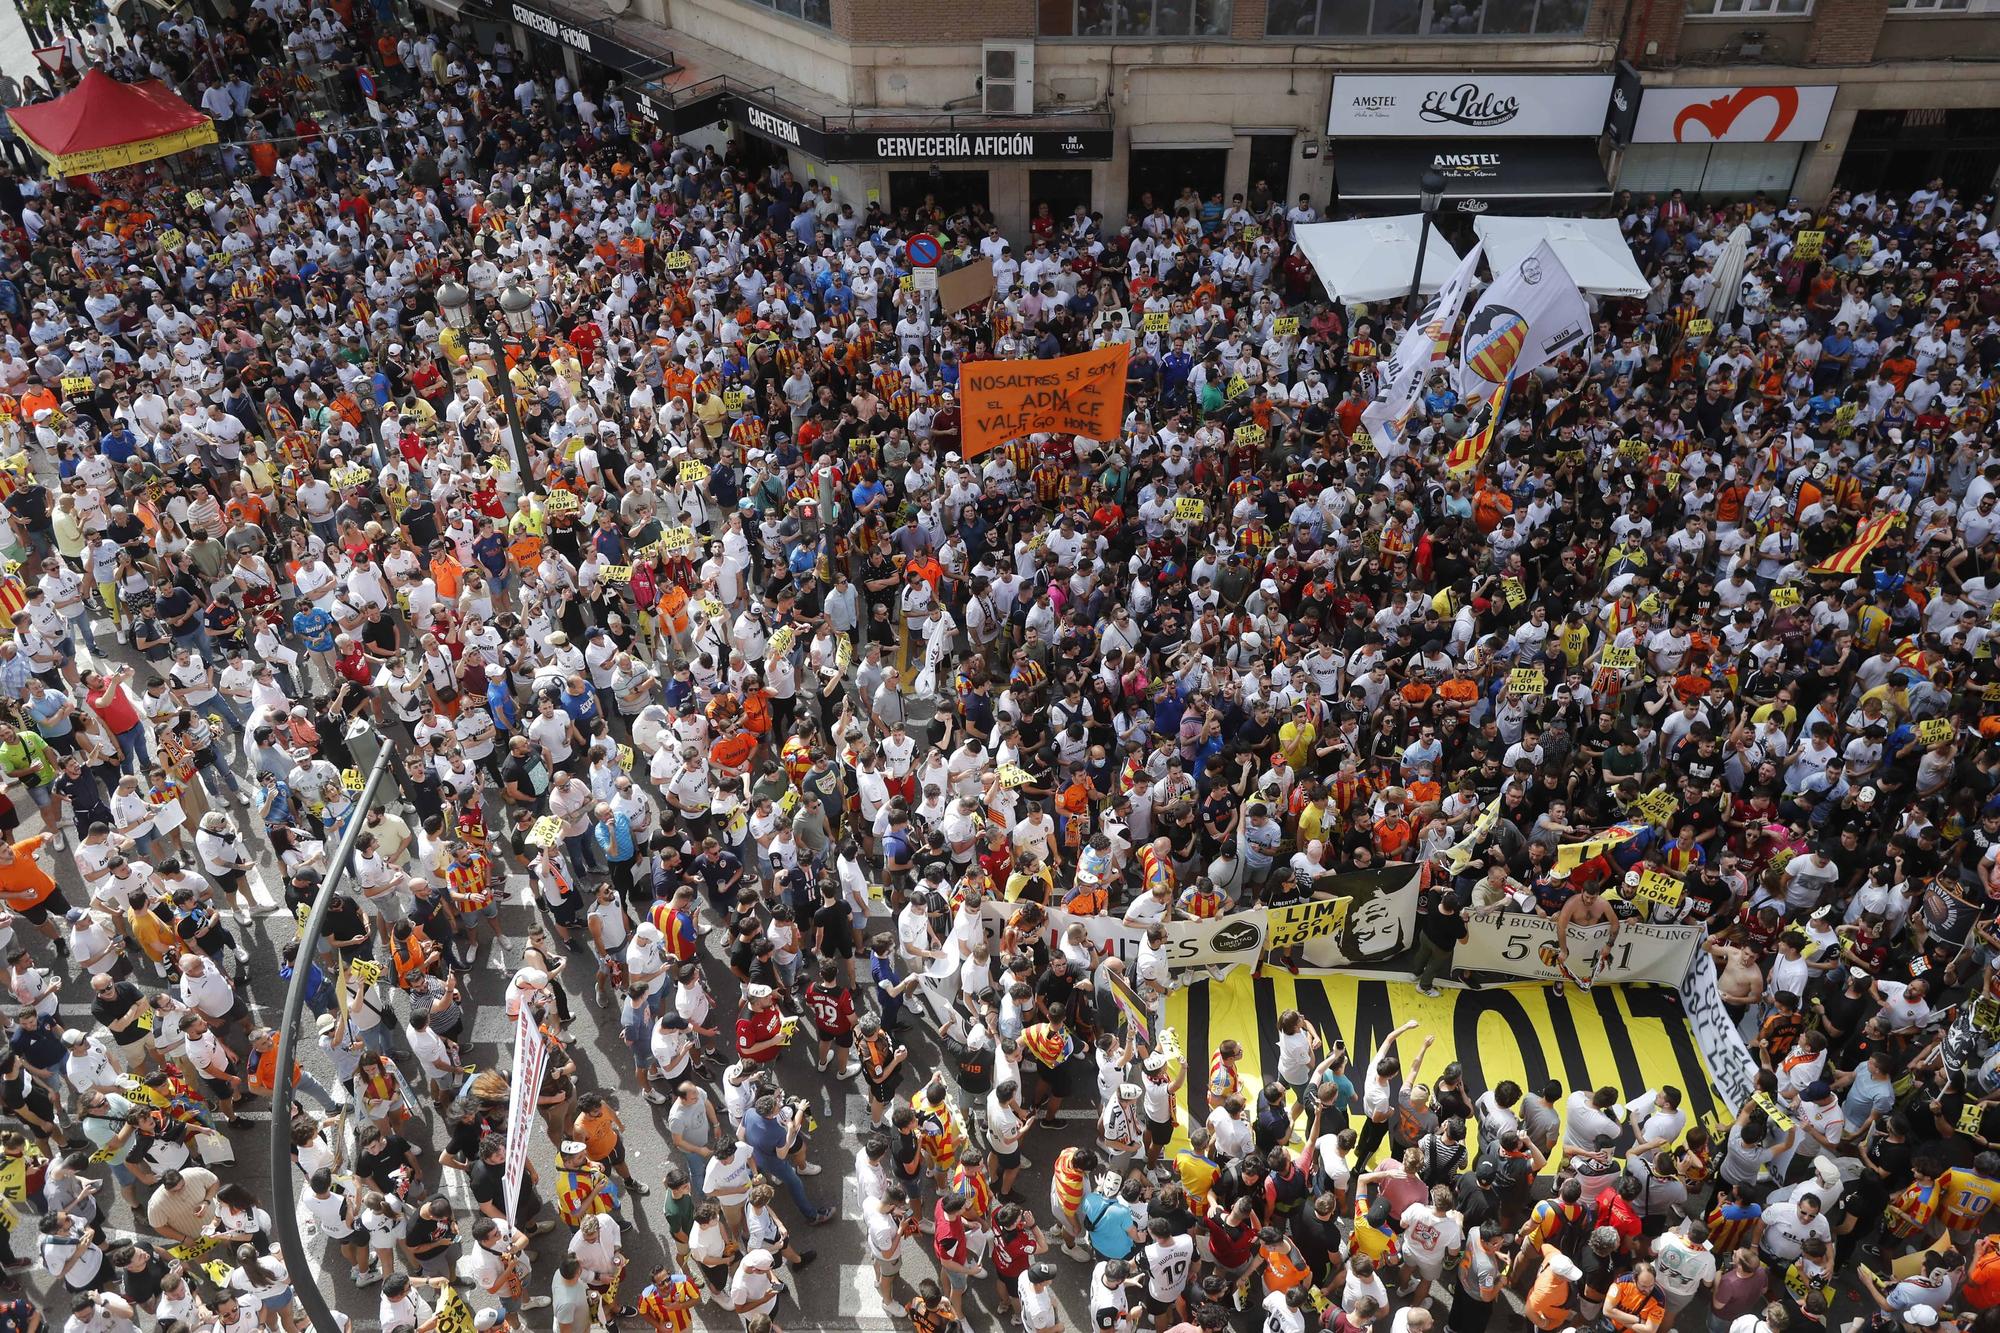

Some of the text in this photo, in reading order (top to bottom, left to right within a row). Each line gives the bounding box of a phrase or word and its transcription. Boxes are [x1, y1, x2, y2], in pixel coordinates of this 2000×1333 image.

[513, 4, 559, 39] CERVECERÍA
[1351, 96, 1397, 106] AMSTEL
[1449, 83, 1520, 118] Palco
[636, 102, 660, 121] TURIA
[748, 107, 801, 146] CAFETERÍA
[877, 133, 1034, 157] CERVECERÍA AFICIÓN
[1433, 153, 1501, 166] AMSTEL
[161, 230, 176, 241] LIM
[670, 253, 686, 261] LIM
[1279, 318, 1294, 326] LIM
[1275, 328, 1298, 336] HOME
[1553, 330, 1570, 342] 1919
[969, 374, 1061, 392] NOSALTRES
[1087, 362, 1117, 378] SOM
[987, 401, 1003, 409] EL
[1033, 416, 1103, 435] GO HOME
[1240, 425, 1257, 434] LIM
[1239, 436, 1262, 447] HOME
[680, 460, 701, 470] HOME
[346, 469, 363, 479] LIM
[686, 472, 704, 480] LIM
[551, 490, 569, 498] LIM
[548, 501, 579, 510] HOME
[1181, 499, 1199, 507] LIM
[1175, 511, 1203, 520] HOME
[666, 527, 684, 538] LIM
[664, 537, 693, 550] HOME
[641, 544, 657, 555] LIM
[520, 550, 538, 561] bwin
[606, 566, 626, 574] LIM
[1775, 589, 1791, 597] LIM
[1698, 601, 1711, 609] LIM
[1568, 634, 1581, 642] LIM
[1568, 642, 1581, 651] OUT
[1610, 647, 1630, 656] LIM
[1603, 659, 1636, 668] HOME
[1516, 670, 1537, 678] LIM
[1510, 683, 1542, 692] HOME
[1926, 720, 1946, 729] LIM
[1920, 732, 1952, 744] HOME
[1655, 793, 1674, 806] LIM
[1640, 800, 1670, 821] HOME
[544, 819, 561, 847] HOME
[1649, 873, 1676, 889] LIM
[1654, 884, 1666, 893] GO
[1639, 886, 1677, 905] HOME
[1285, 900, 1337, 923] LIM
[1296, 918, 1323, 931] GO
[1271, 920, 1343, 947] HOME
[1623, 924, 1693, 944] FEELING
[1218, 936, 1254, 949] LIBERTAD
[1501, 932, 1534, 963] 5
[814, 1002, 838, 1023] 19
[1186, 974, 1738, 1162] LIM OUT
[1960, 1190, 1992, 1213] 10
[1158, 1251, 1188, 1266] HUGO DURO
[1162, 1259, 1187, 1286] 19
